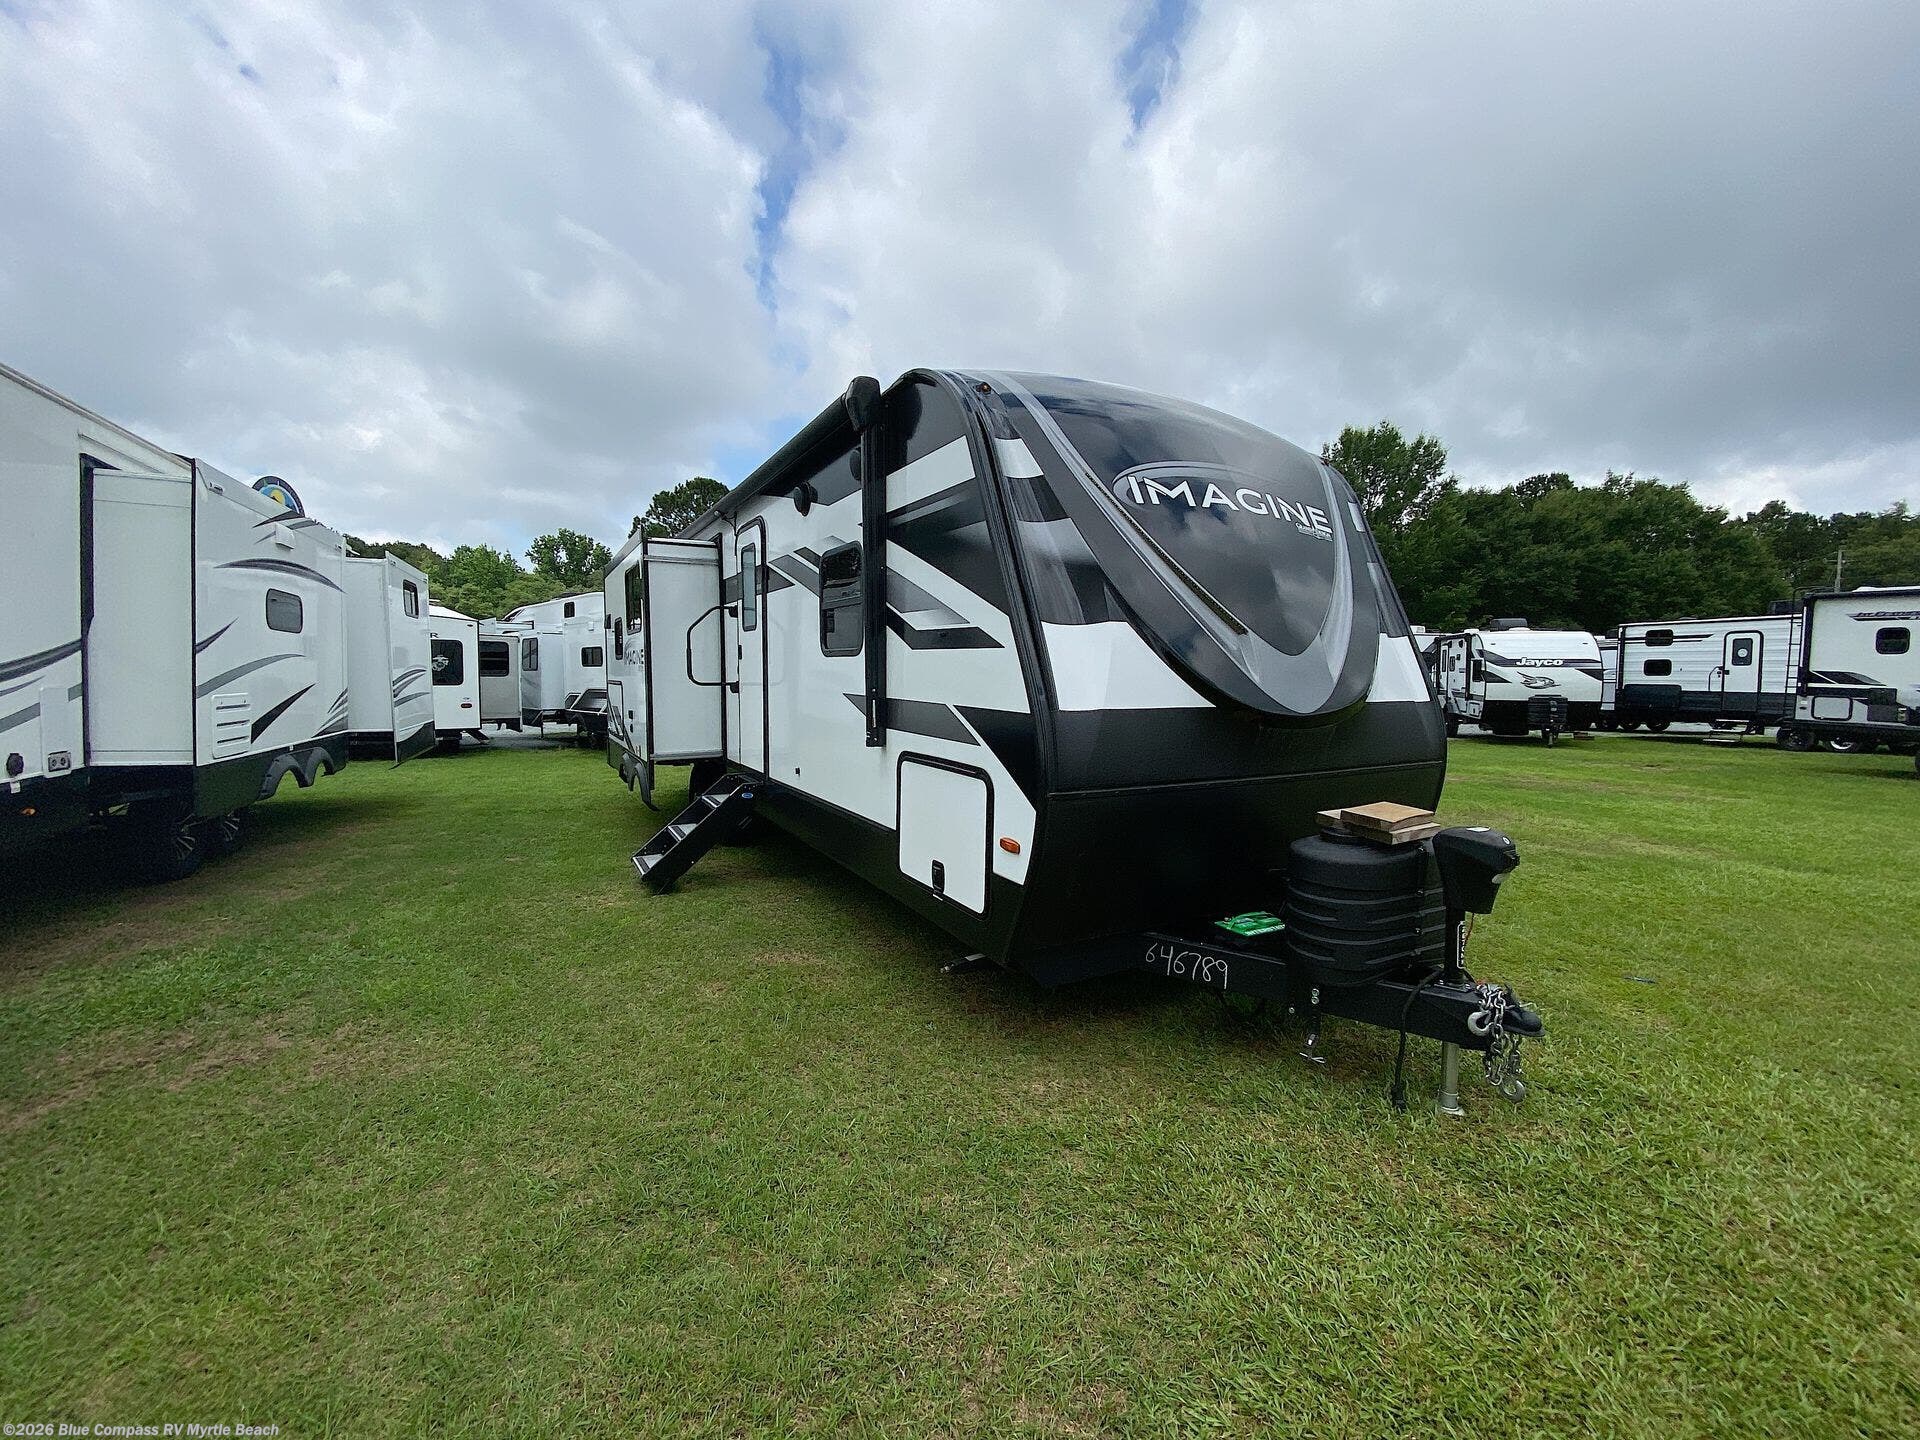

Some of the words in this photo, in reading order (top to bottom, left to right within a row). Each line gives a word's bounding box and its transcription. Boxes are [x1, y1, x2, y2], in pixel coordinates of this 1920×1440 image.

[1127, 475, 1333, 533] IMAGINE
[1515, 657, 1563, 668] Jayco
[1145, 942, 1228, 990] 646789
